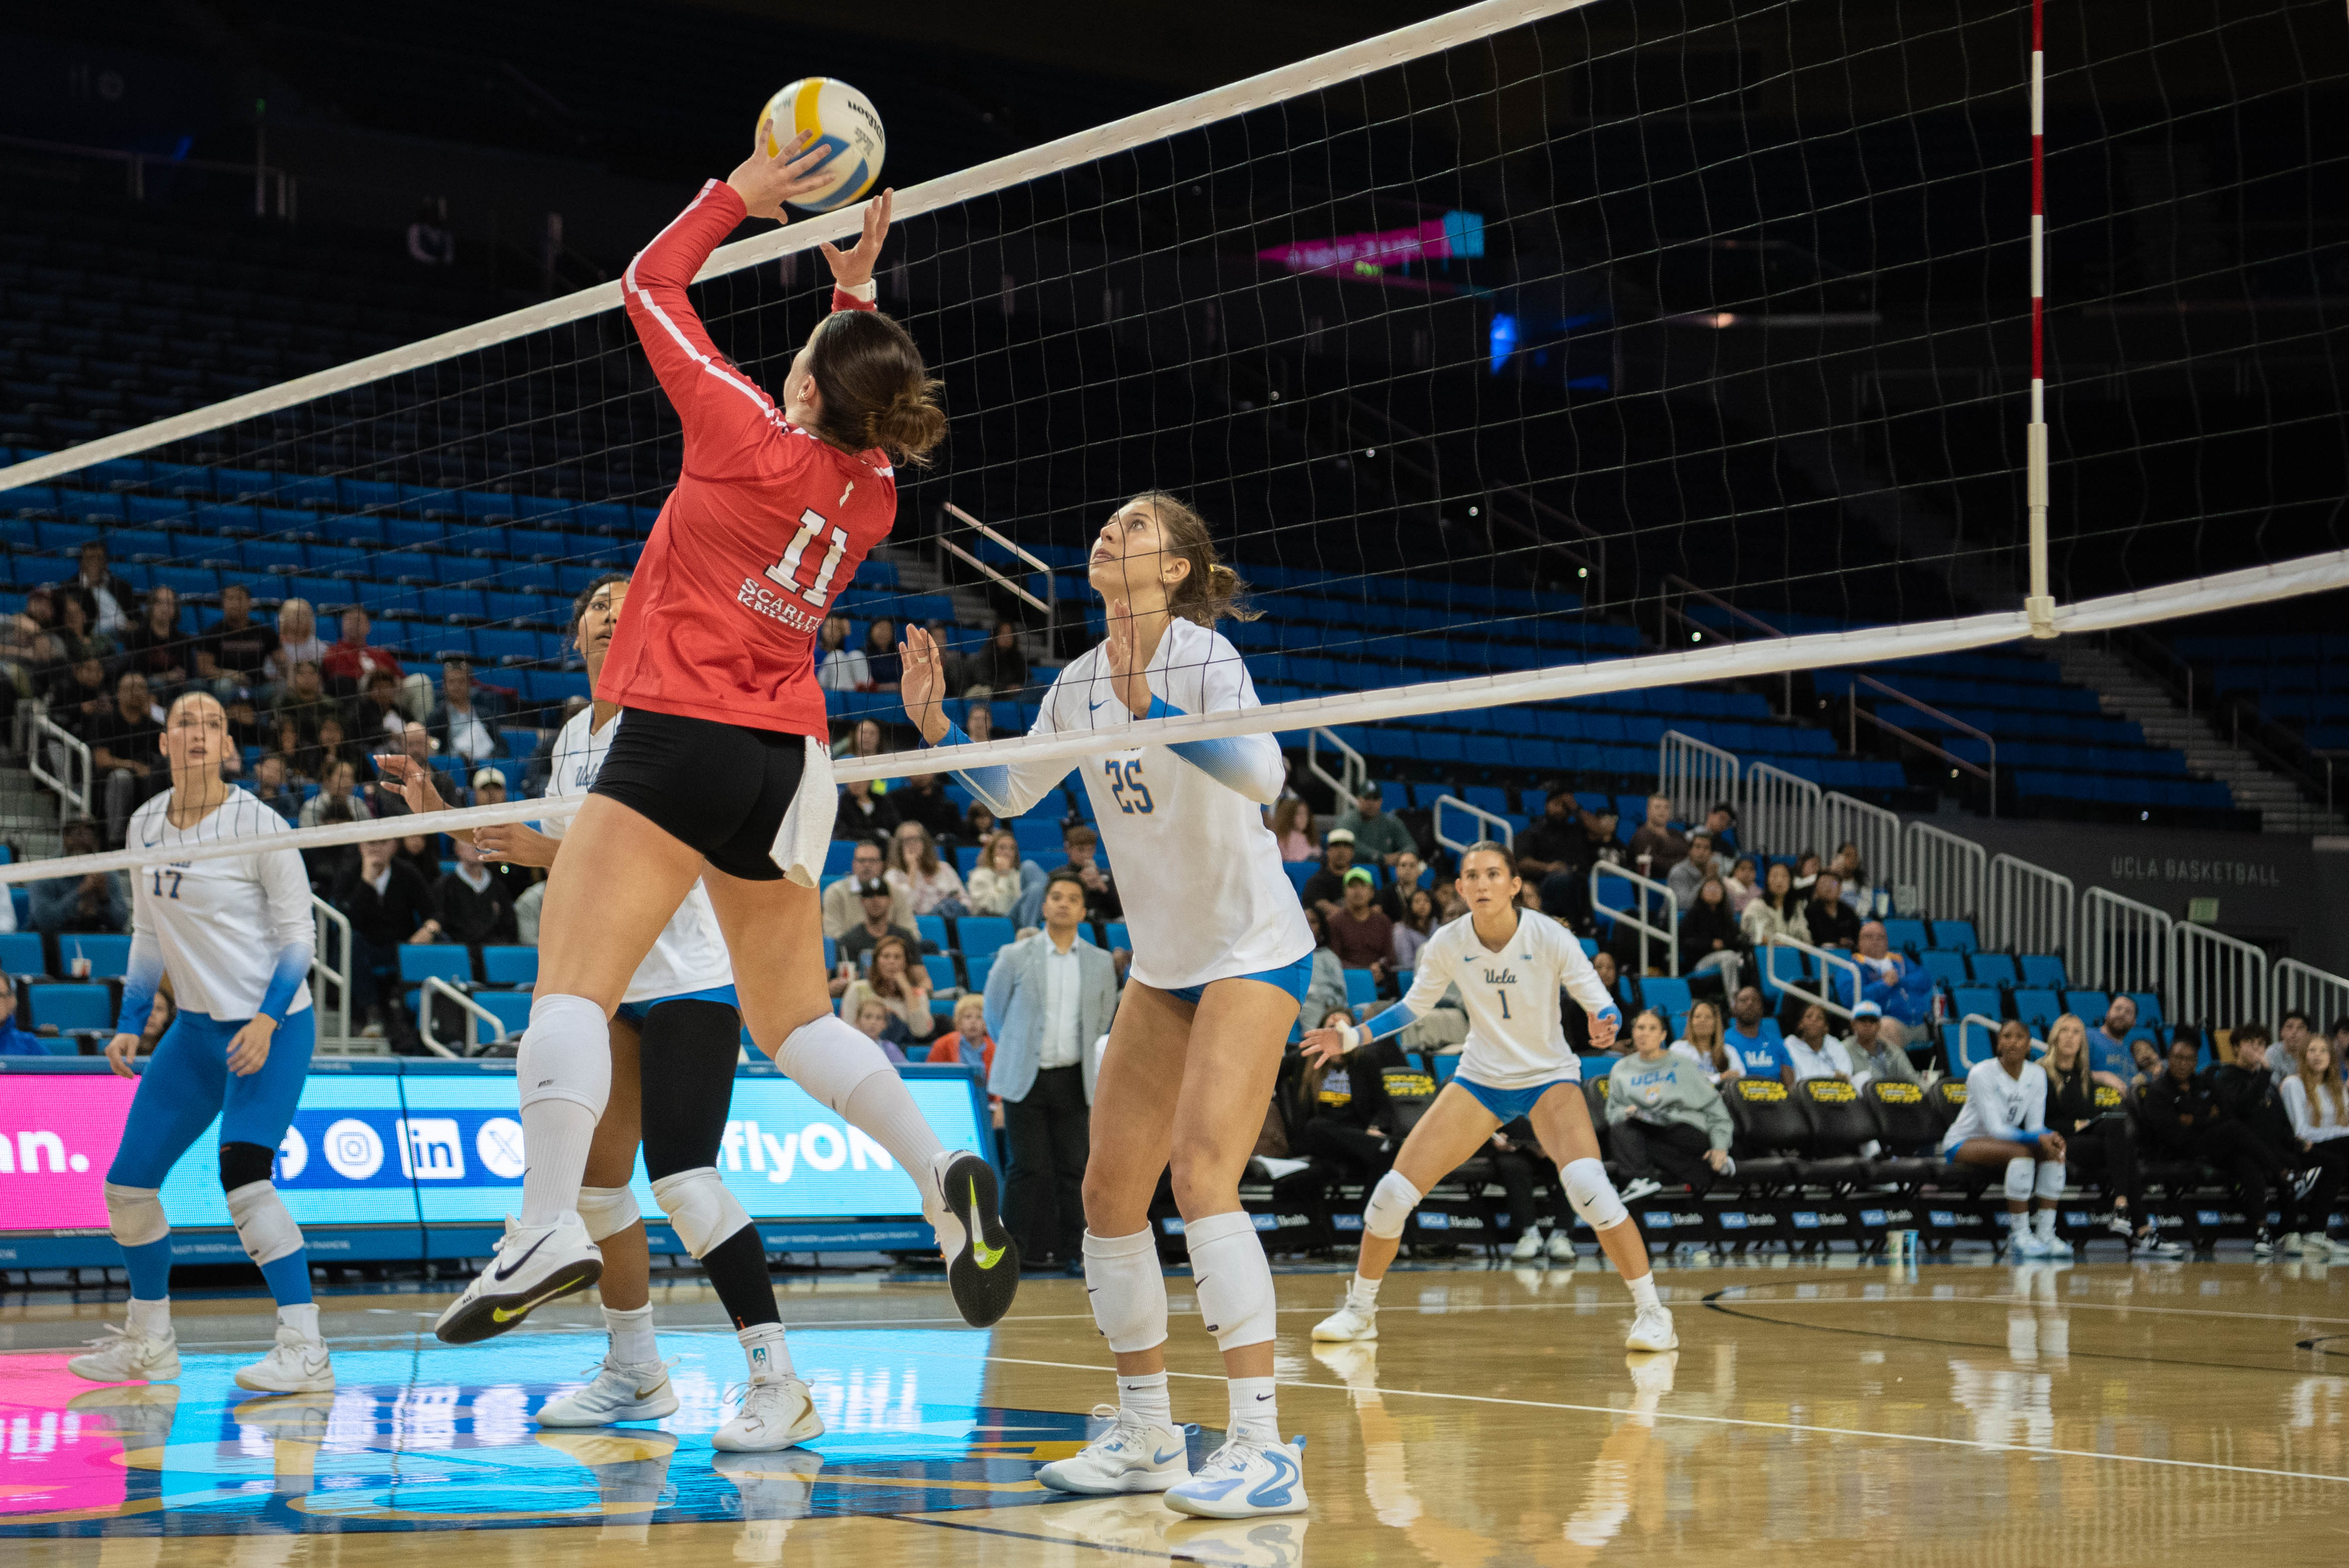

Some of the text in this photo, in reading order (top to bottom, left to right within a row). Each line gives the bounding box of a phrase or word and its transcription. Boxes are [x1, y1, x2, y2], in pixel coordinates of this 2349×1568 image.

[763, 506, 849, 608] 11
[1104, 757, 1155, 815] 25
[153, 870, 184, 899] 17
[2110, 855, 2280, 887] UCLA BASKETBALL
[1484, 968, 1517, 984] Ucla
[1497, 989, 1511, 1020] 1
[1631, 1071, 1676, 1086] UCLA
